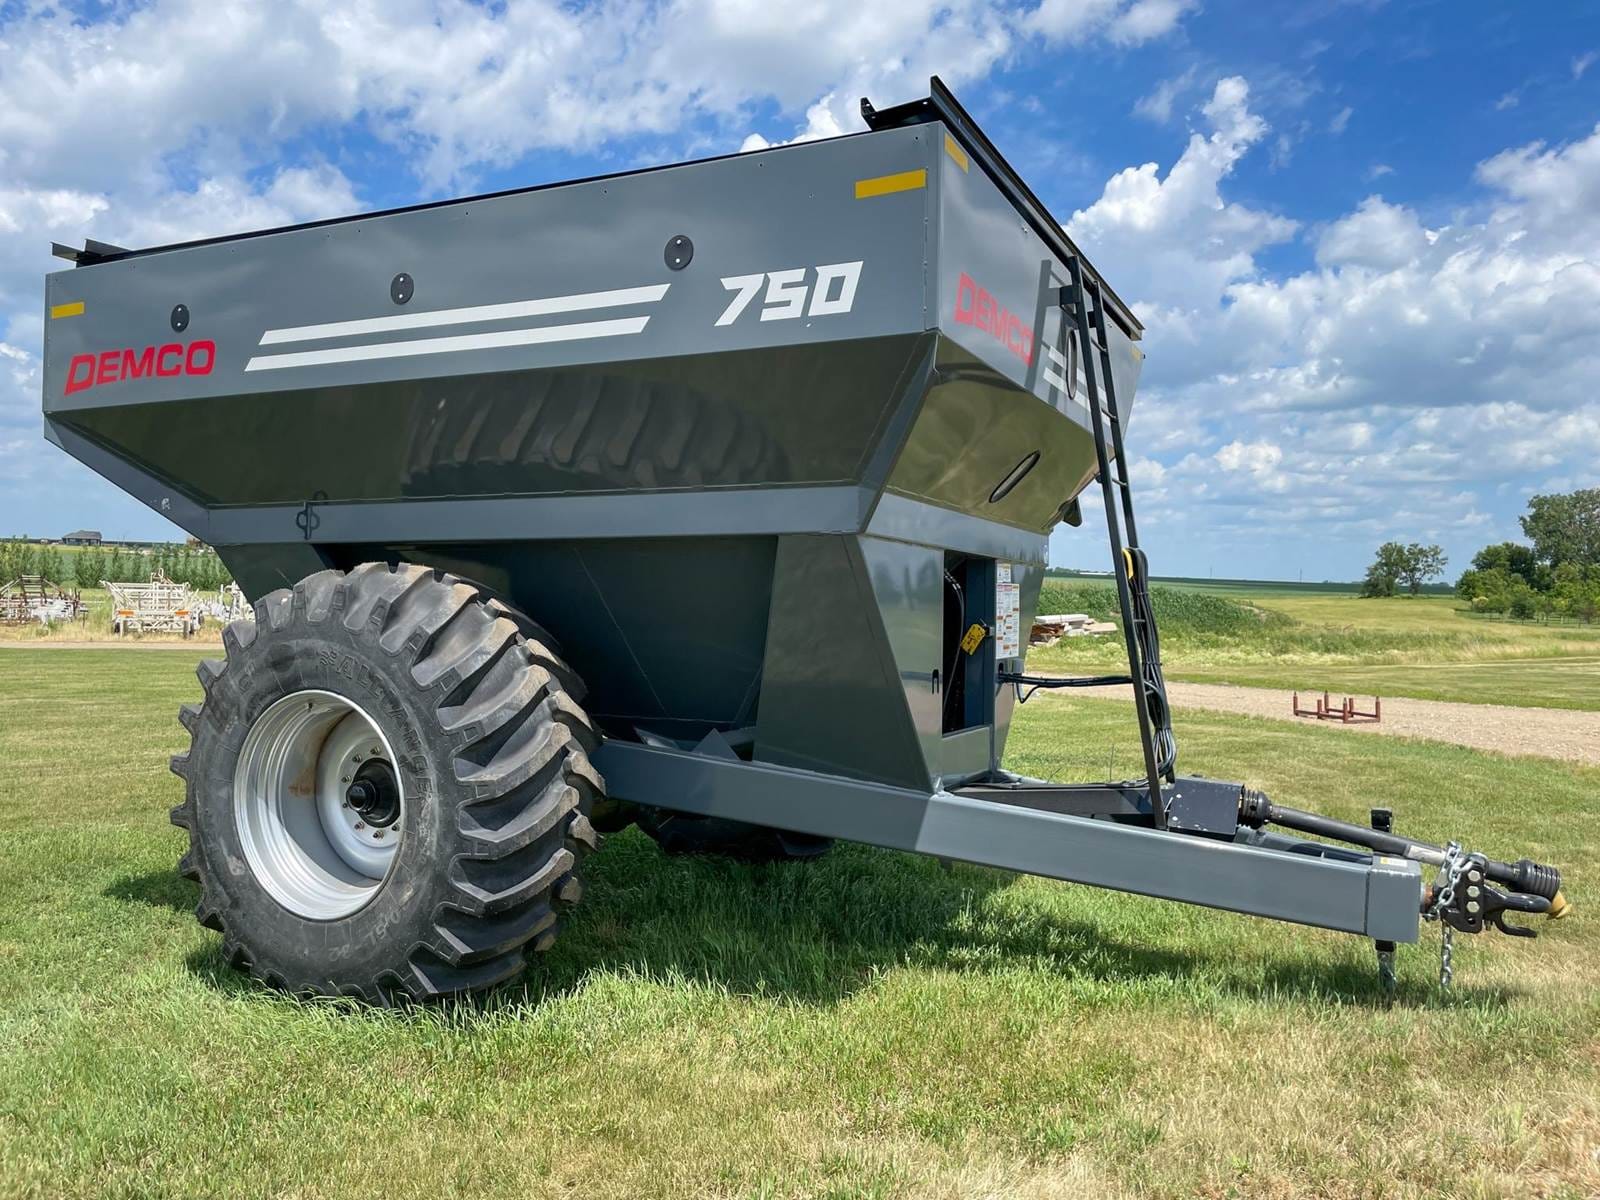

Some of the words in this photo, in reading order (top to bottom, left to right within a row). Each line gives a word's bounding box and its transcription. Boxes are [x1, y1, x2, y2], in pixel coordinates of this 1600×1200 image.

[714, 260, 864, 327] 750
[954, 272, 1034, 368] DEMCO
[64, 340, 216, 395] DEMCO
